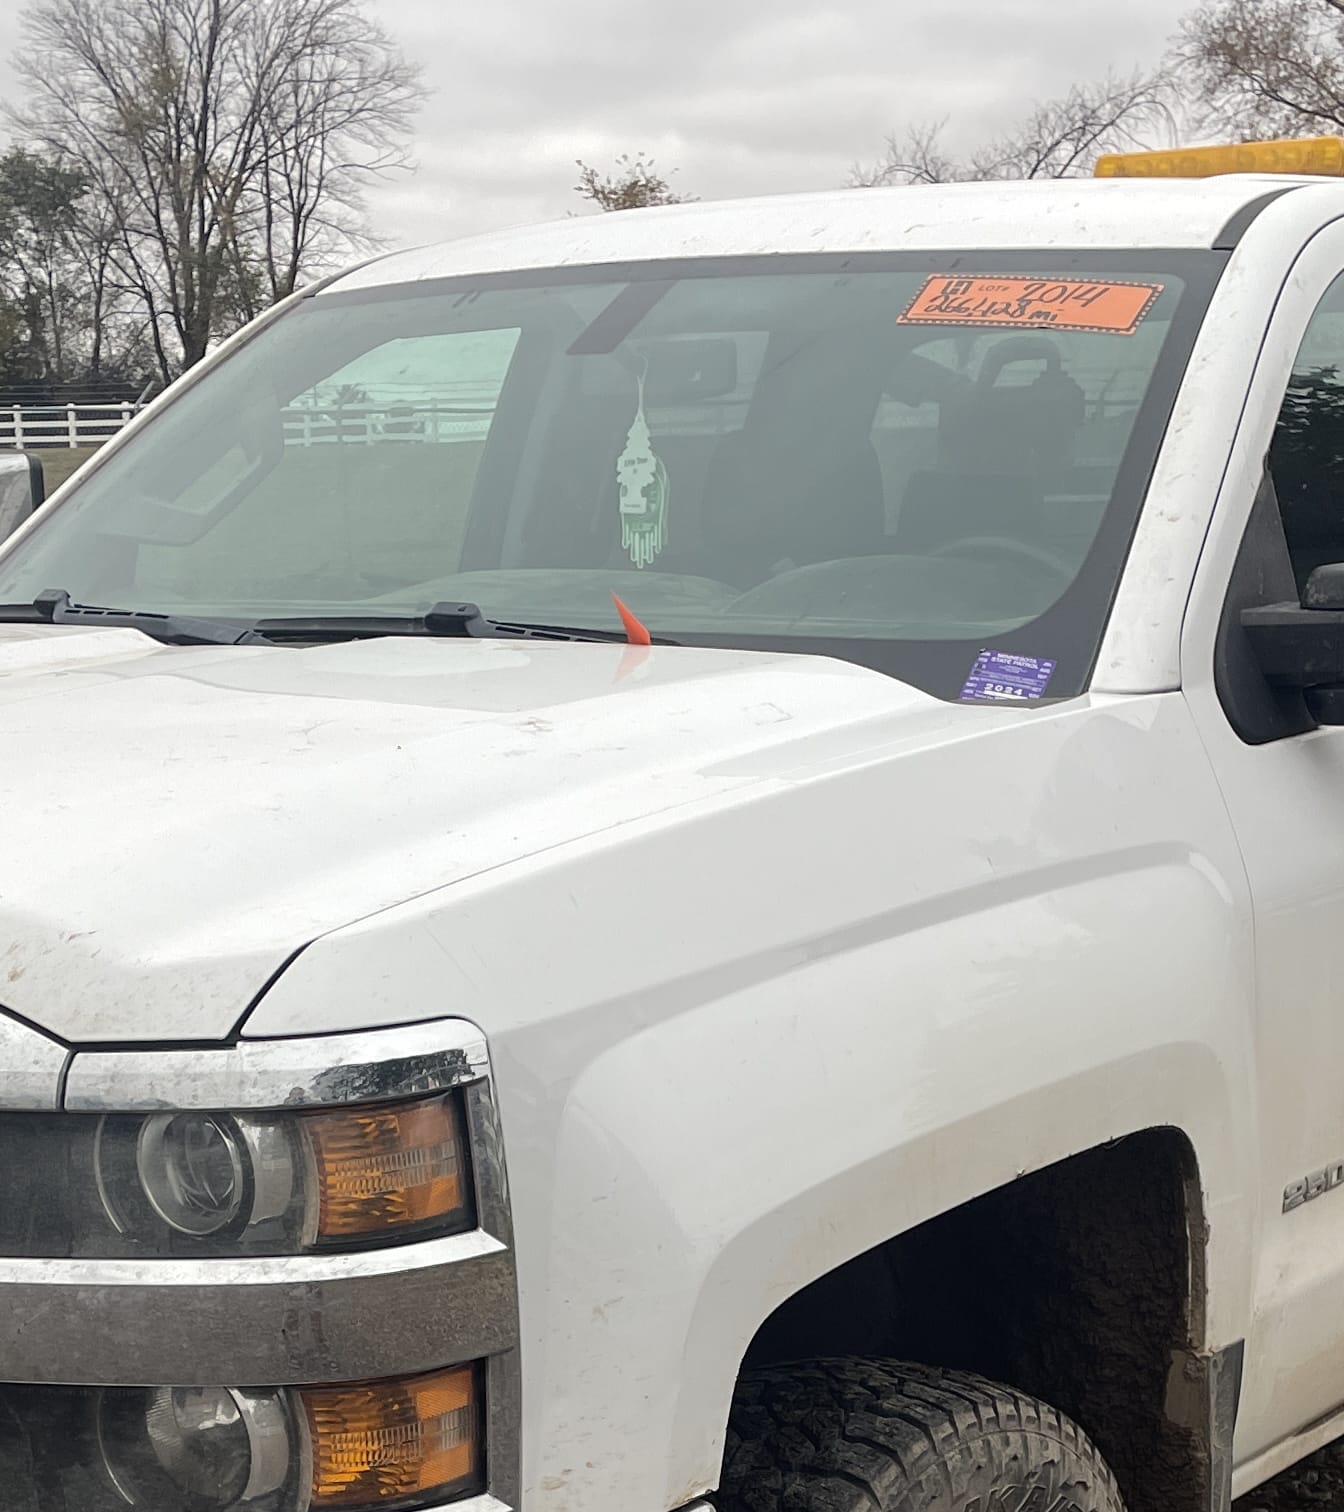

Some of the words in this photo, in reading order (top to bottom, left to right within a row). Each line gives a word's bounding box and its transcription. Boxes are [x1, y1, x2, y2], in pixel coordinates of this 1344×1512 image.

[1016, 282, 1110, 308] 2014
[990, 656, 1013, 665] STATE
[984, 683, 1023, 696] 2024
